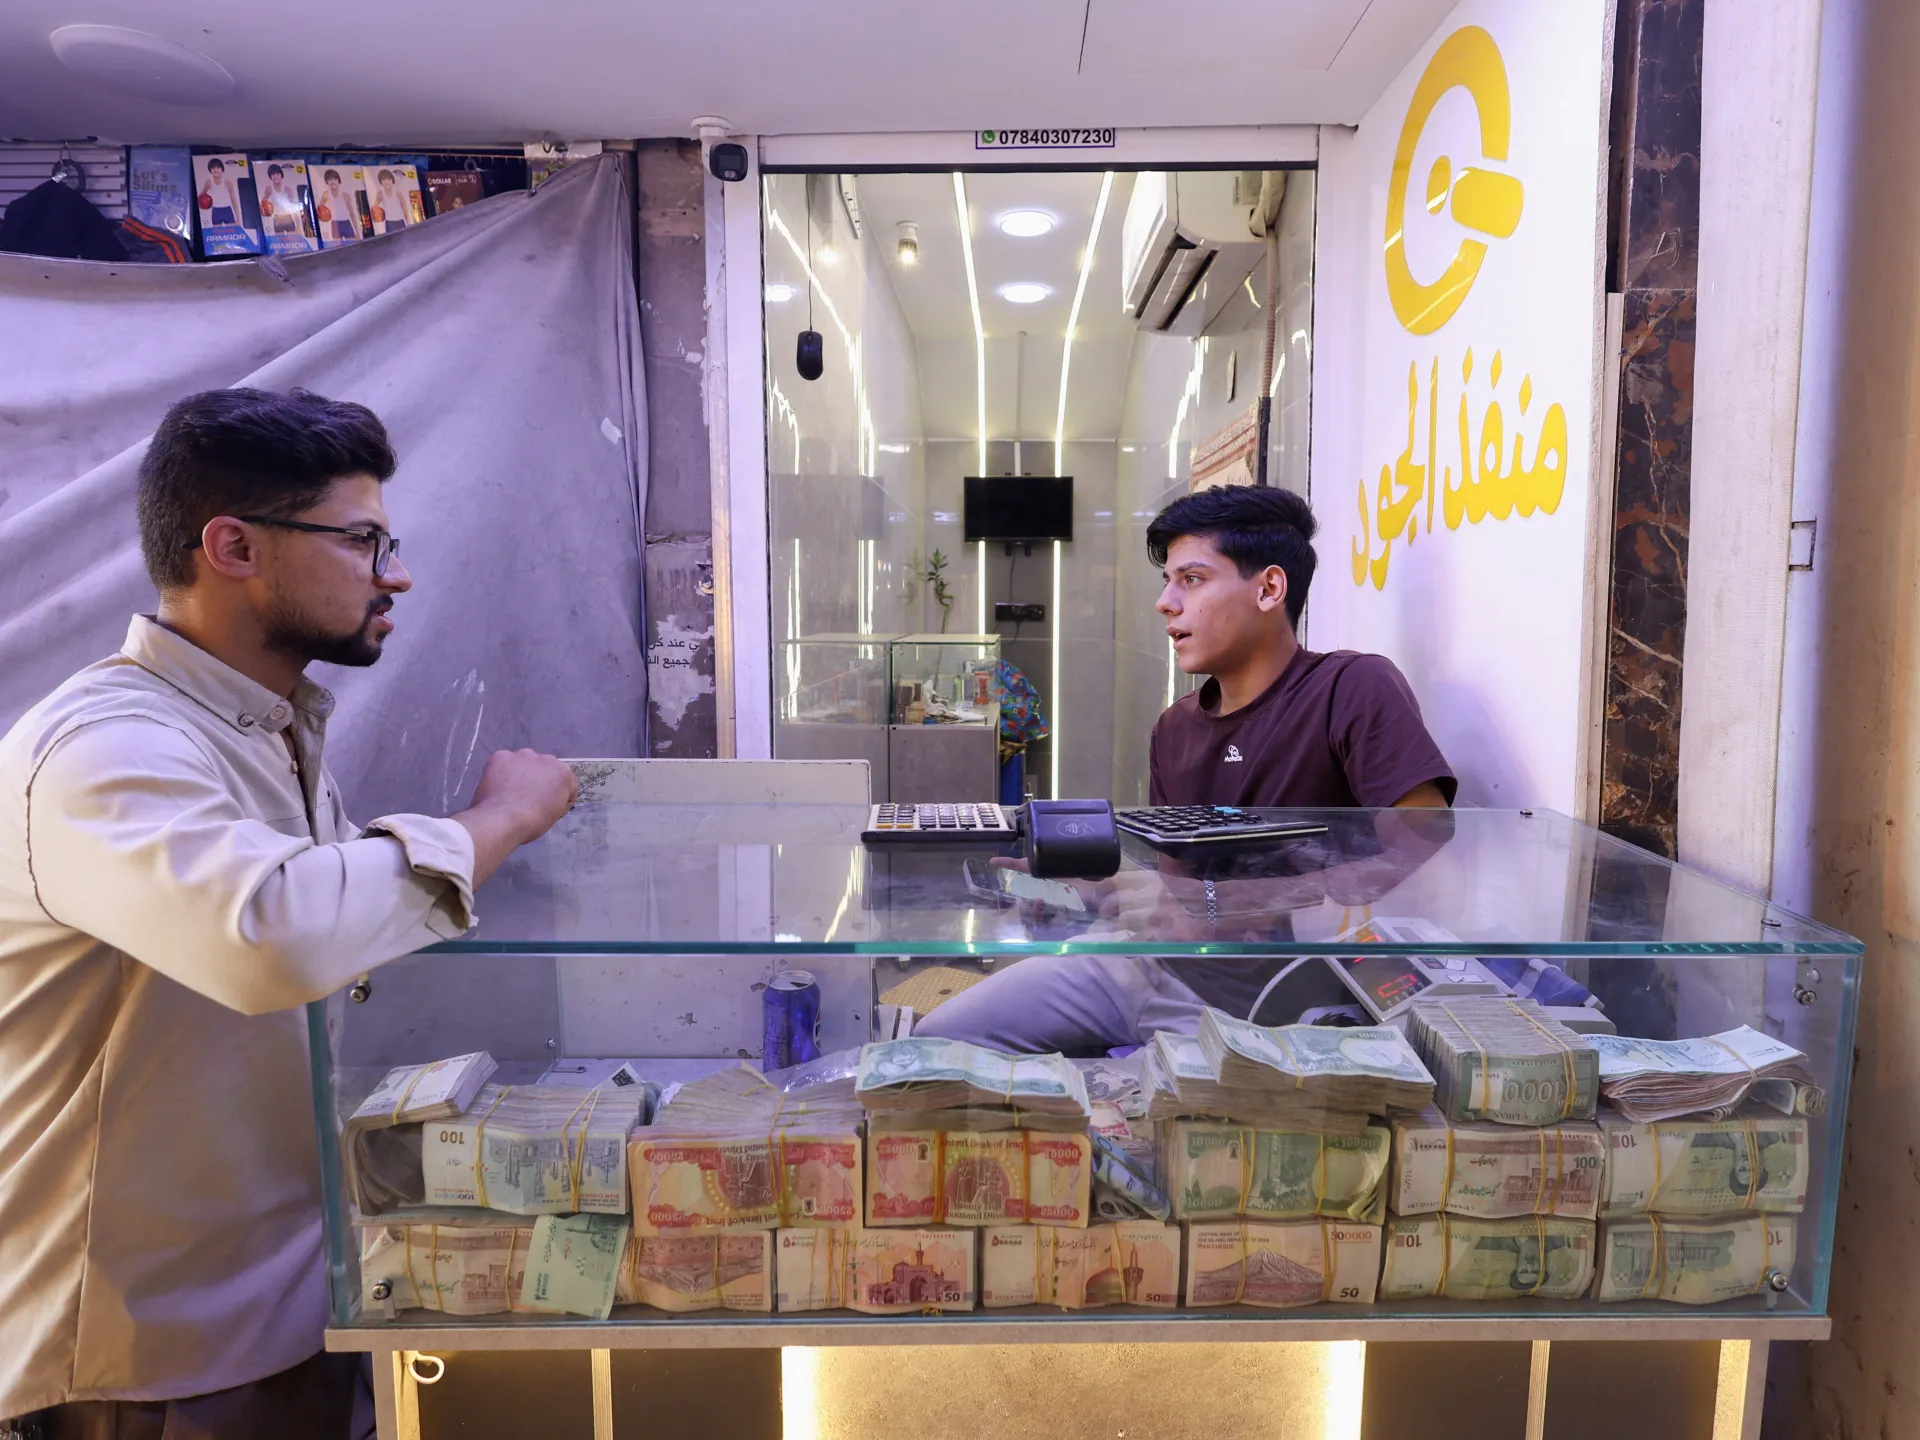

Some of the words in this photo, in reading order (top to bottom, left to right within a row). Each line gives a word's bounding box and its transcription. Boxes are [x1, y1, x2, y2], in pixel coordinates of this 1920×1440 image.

[999, 129, 1112, 144] 07840307230
[1443, 345, 1568, 531] منفذ
[1352, 355, 1439, 591] الجود
[1504, 1081, 1561, 1103] 1000
[440, 1130, 465, 1145] 100
[1621, 1134, 1638, 1148] 10
[1574, 1156, 1598, 1169] 100
[1405, 1235, 1422, 1247] 10
[944, 1292, 960, 1302] 50
[1339, 1287, 1360, 1298] 50
